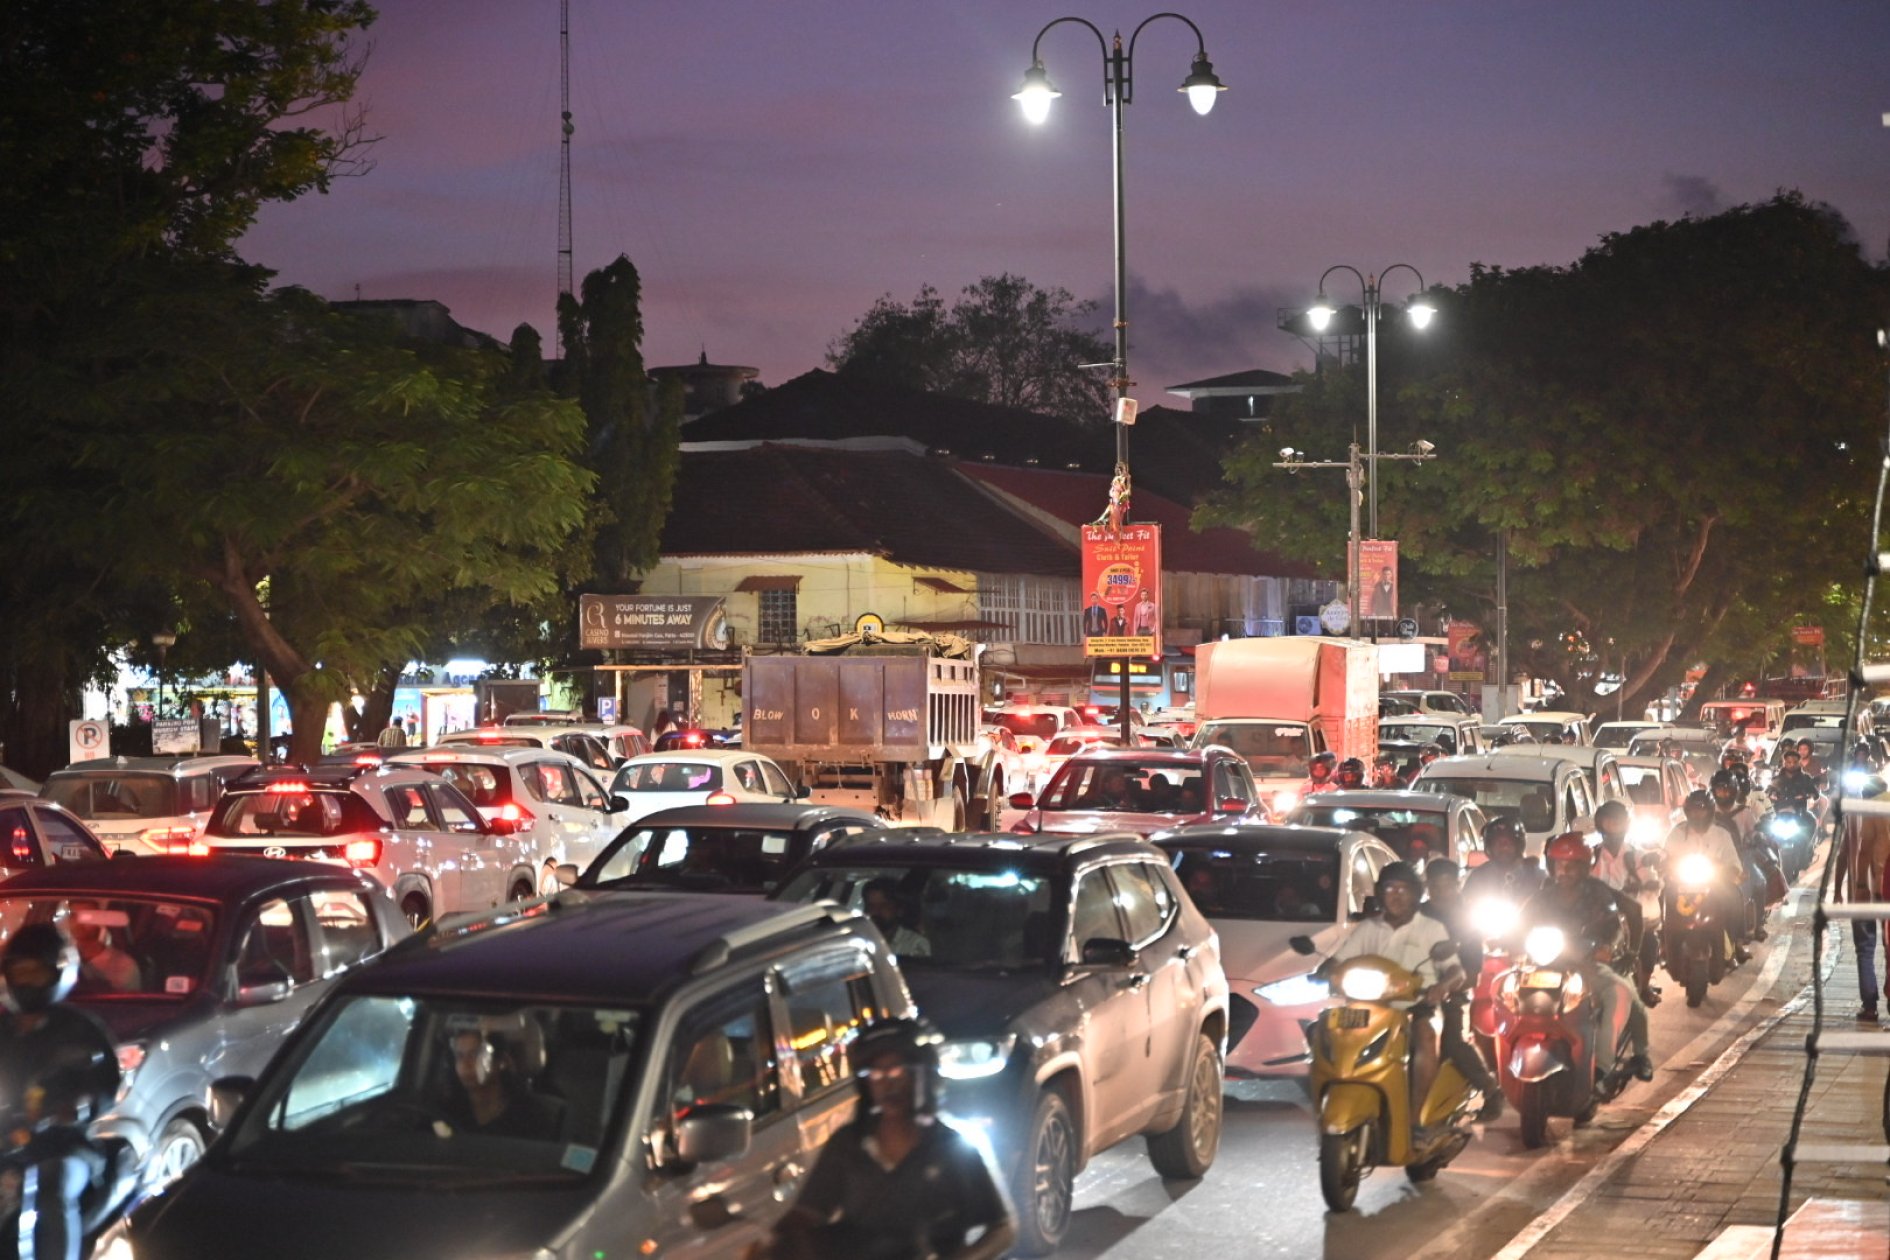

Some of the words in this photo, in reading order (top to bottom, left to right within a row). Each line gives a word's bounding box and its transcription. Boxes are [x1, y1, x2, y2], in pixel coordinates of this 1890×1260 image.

[615, 604, 633, 612] YOUR
[635, 604, 666, 612] FORTUNE
[667, 604, 674, 612] IS
[676, 604, 692, 612] JUST
[615, 615, 622, 625] 6
[624, 614, 665, 625] MINUTES
[666, 614, 692, 625] AWAY
[601, 699, 612, 715] P
[753, 708, 784, 721] BLOW
[811, 707, 820, 720] O
[849, 707, 859, 721] K
[888, 708, 918, 721] HORN
[83, 728, 97, 744] P
